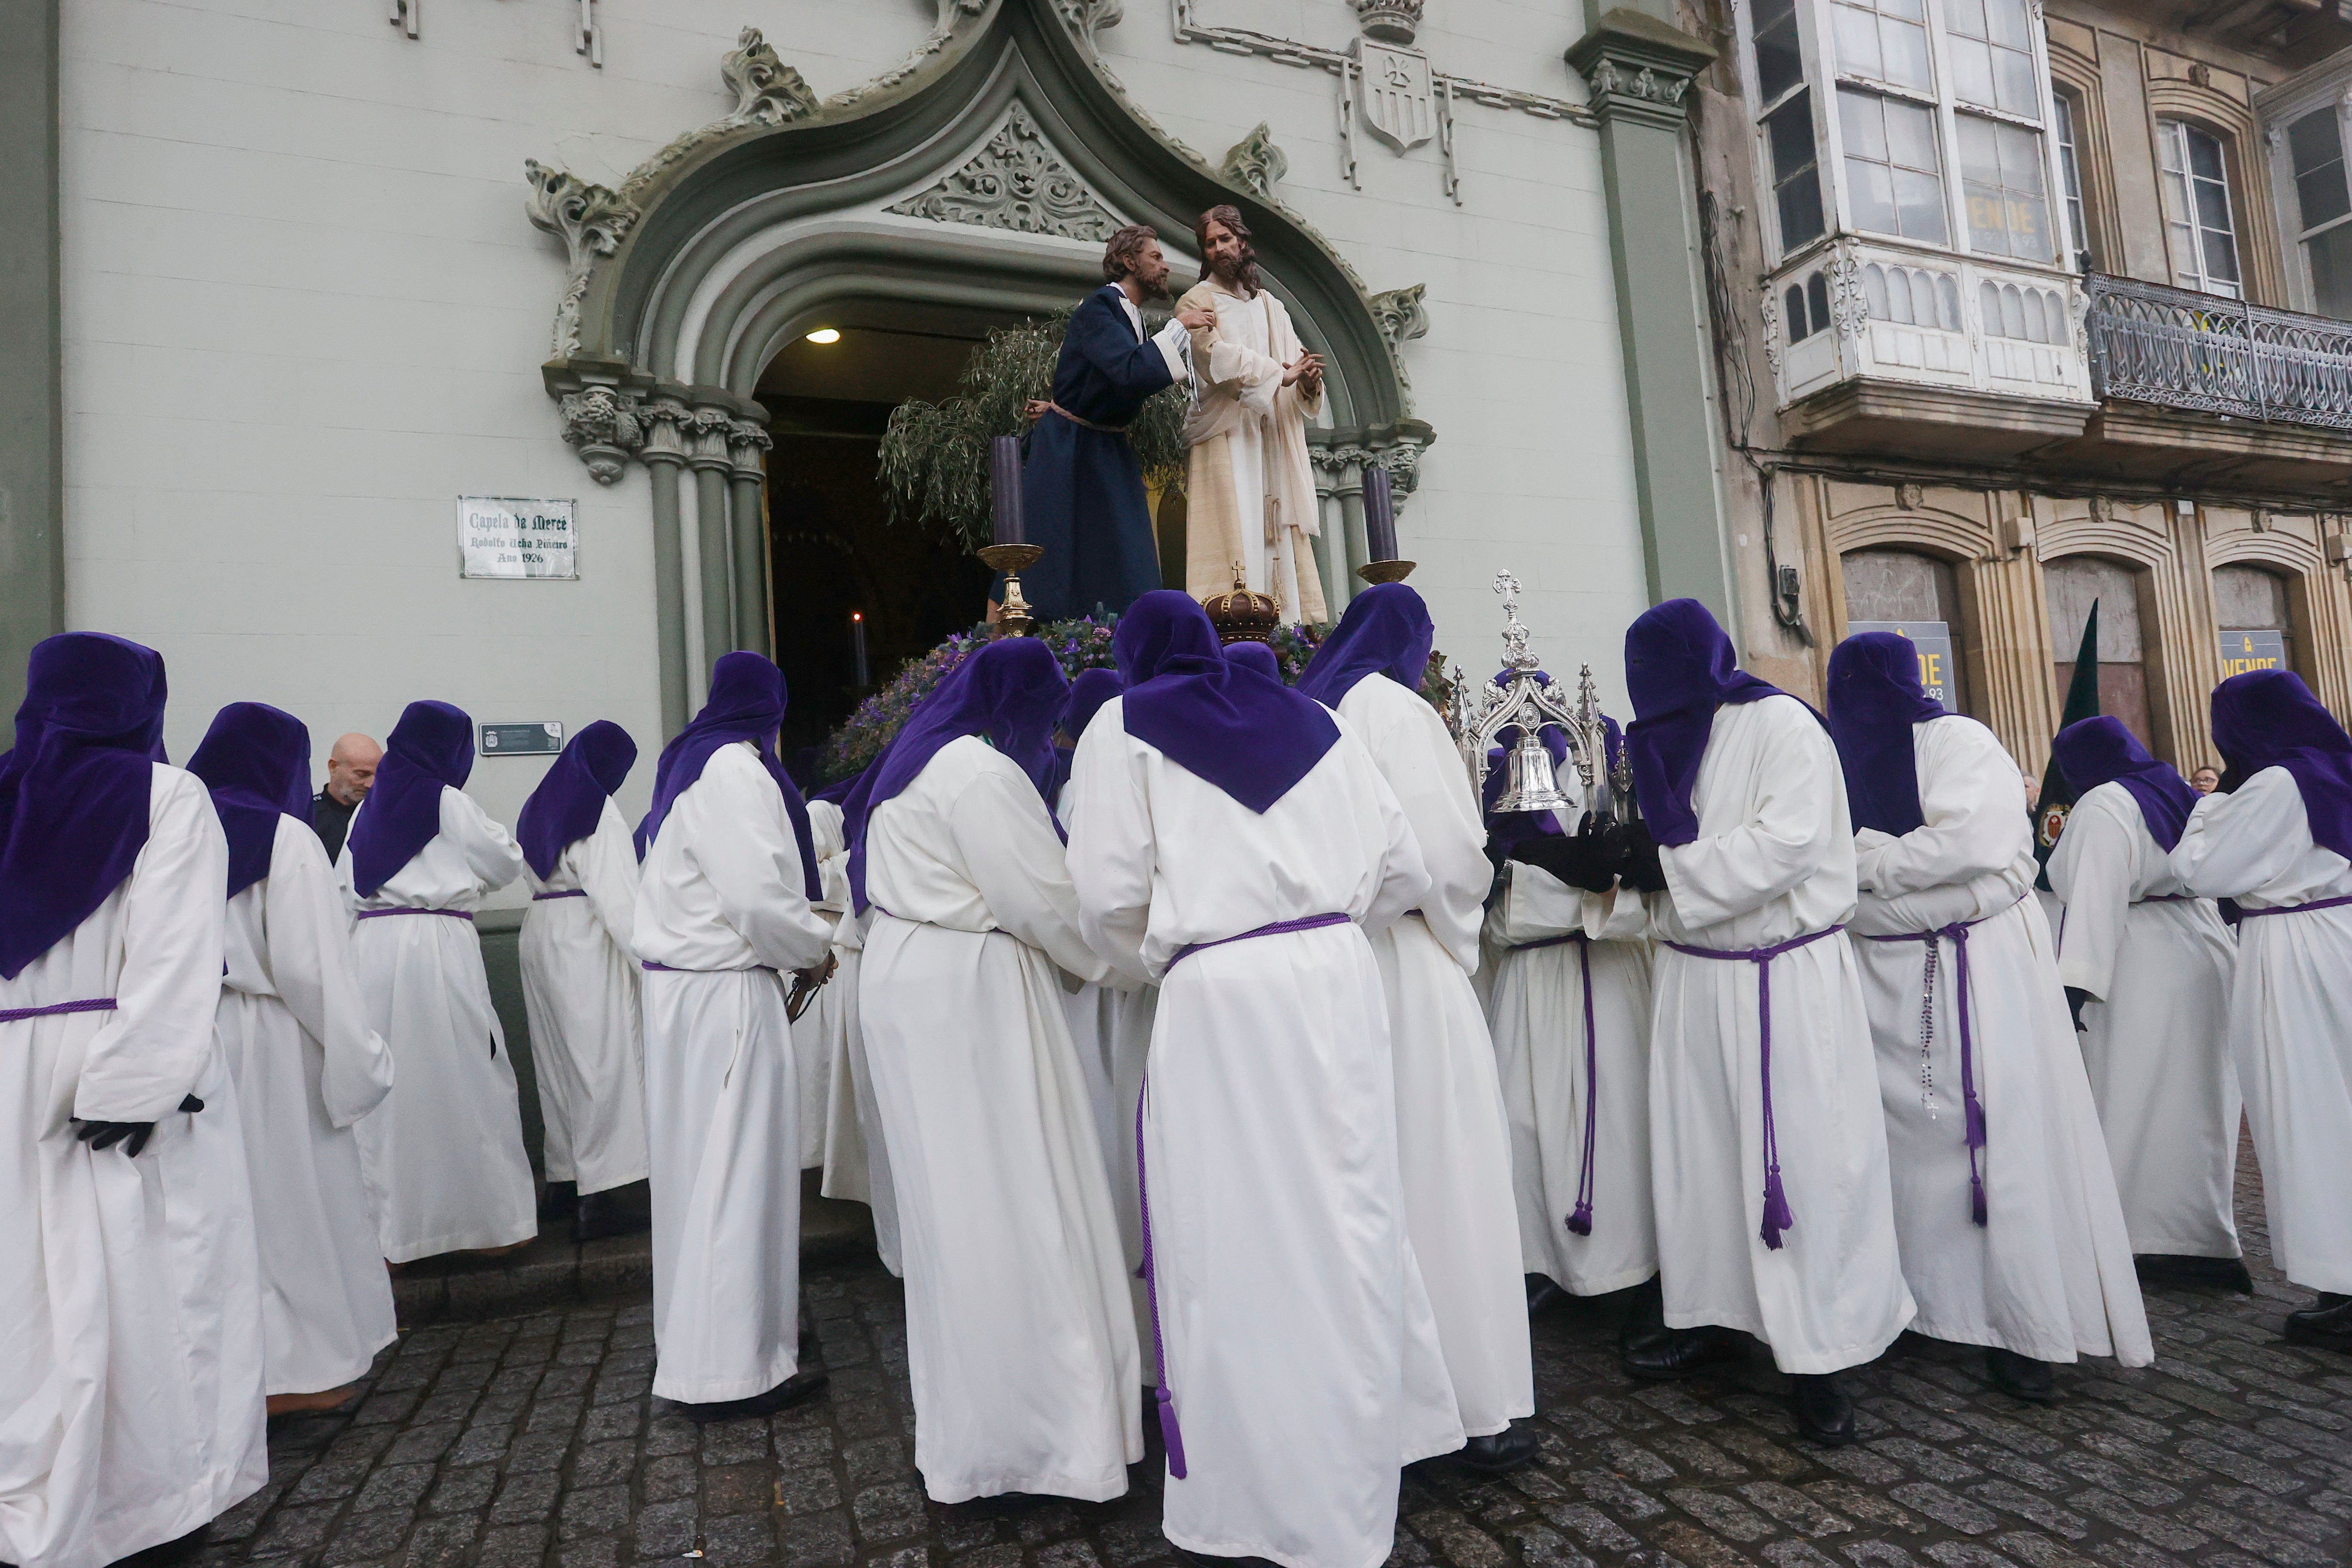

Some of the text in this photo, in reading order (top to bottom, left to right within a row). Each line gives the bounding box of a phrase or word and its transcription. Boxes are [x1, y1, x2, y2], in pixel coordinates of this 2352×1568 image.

[469, 513, 509, 532] Capela
[514, 513, 527, 529] da
[471, 537, 567, 549] Rodolfo Ucha Piñeiro
[497, 553, 543, 563] Ano 1926
